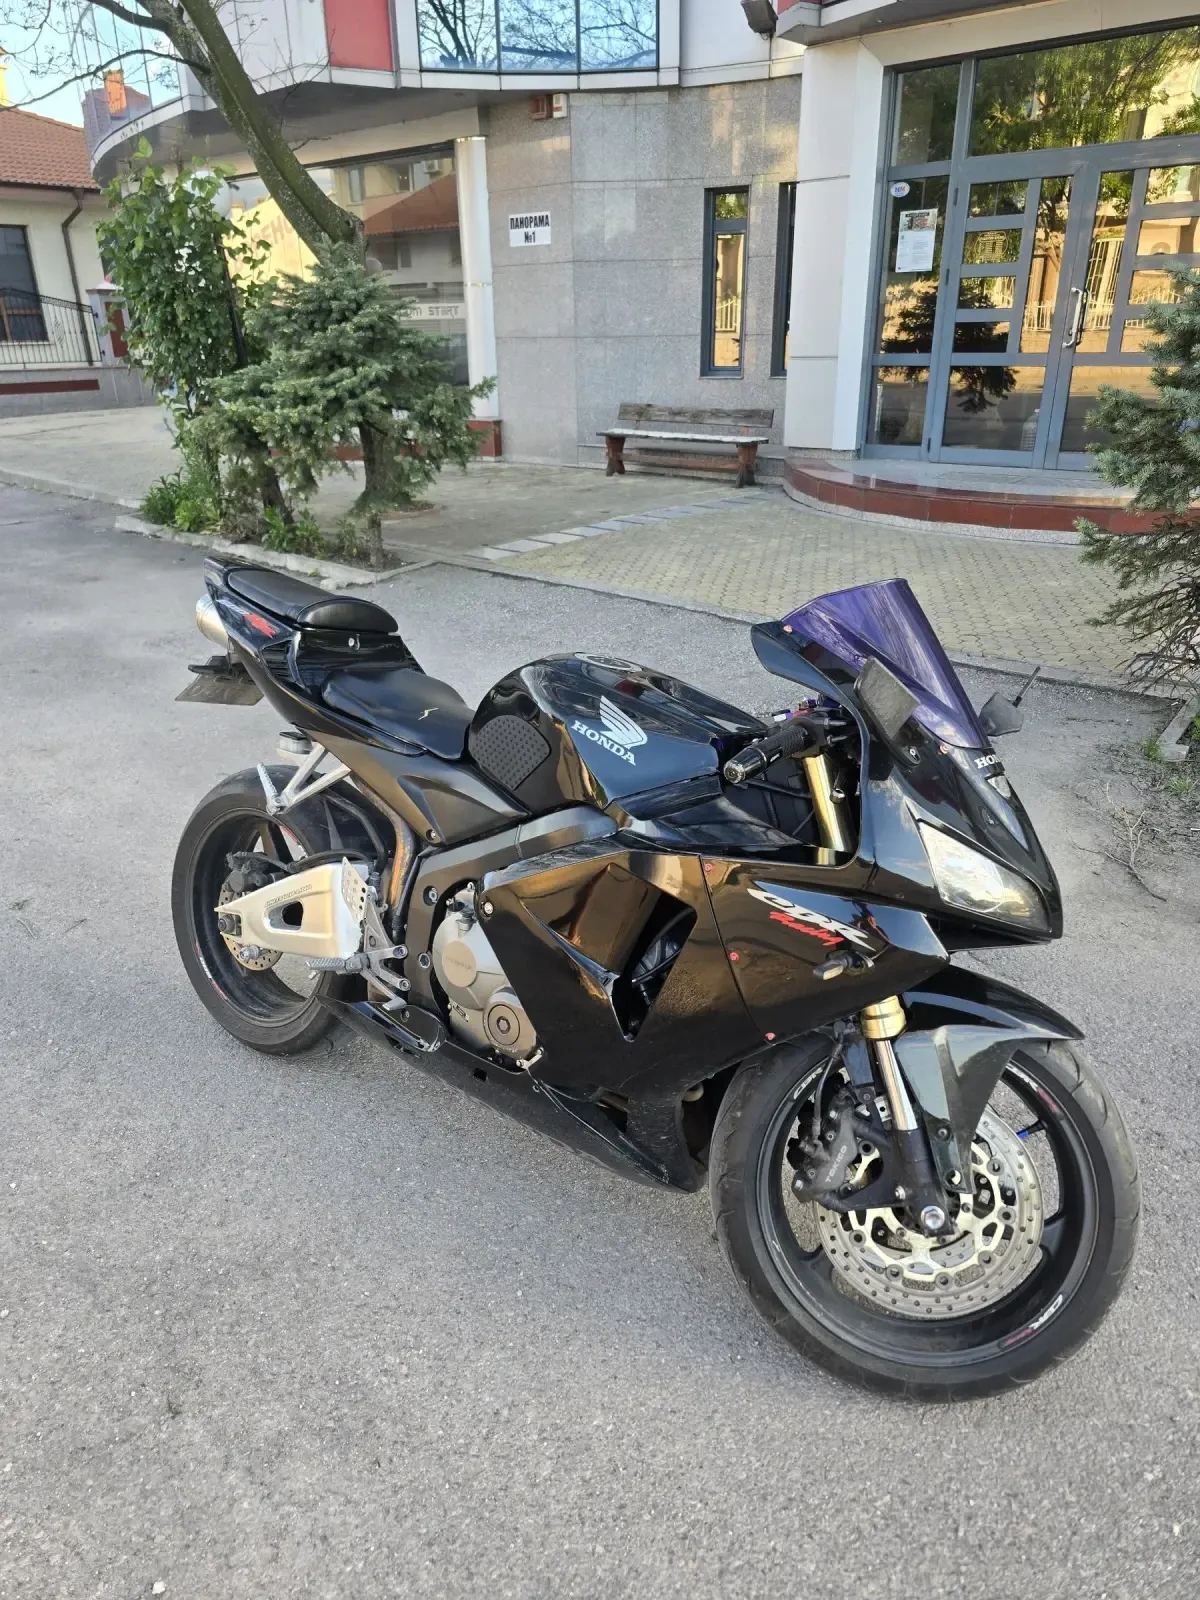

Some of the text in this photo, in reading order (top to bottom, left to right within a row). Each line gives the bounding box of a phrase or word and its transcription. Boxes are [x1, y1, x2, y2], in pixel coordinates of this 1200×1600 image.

[510, 214, 550, 230] ПАНОРАМА
[524, 231, 536, 244] №1
[571, 720, 636, 766] HONDA
[746, 888, 877, 952] CBR
[1028, 1294, 1063, 1330] CBR
